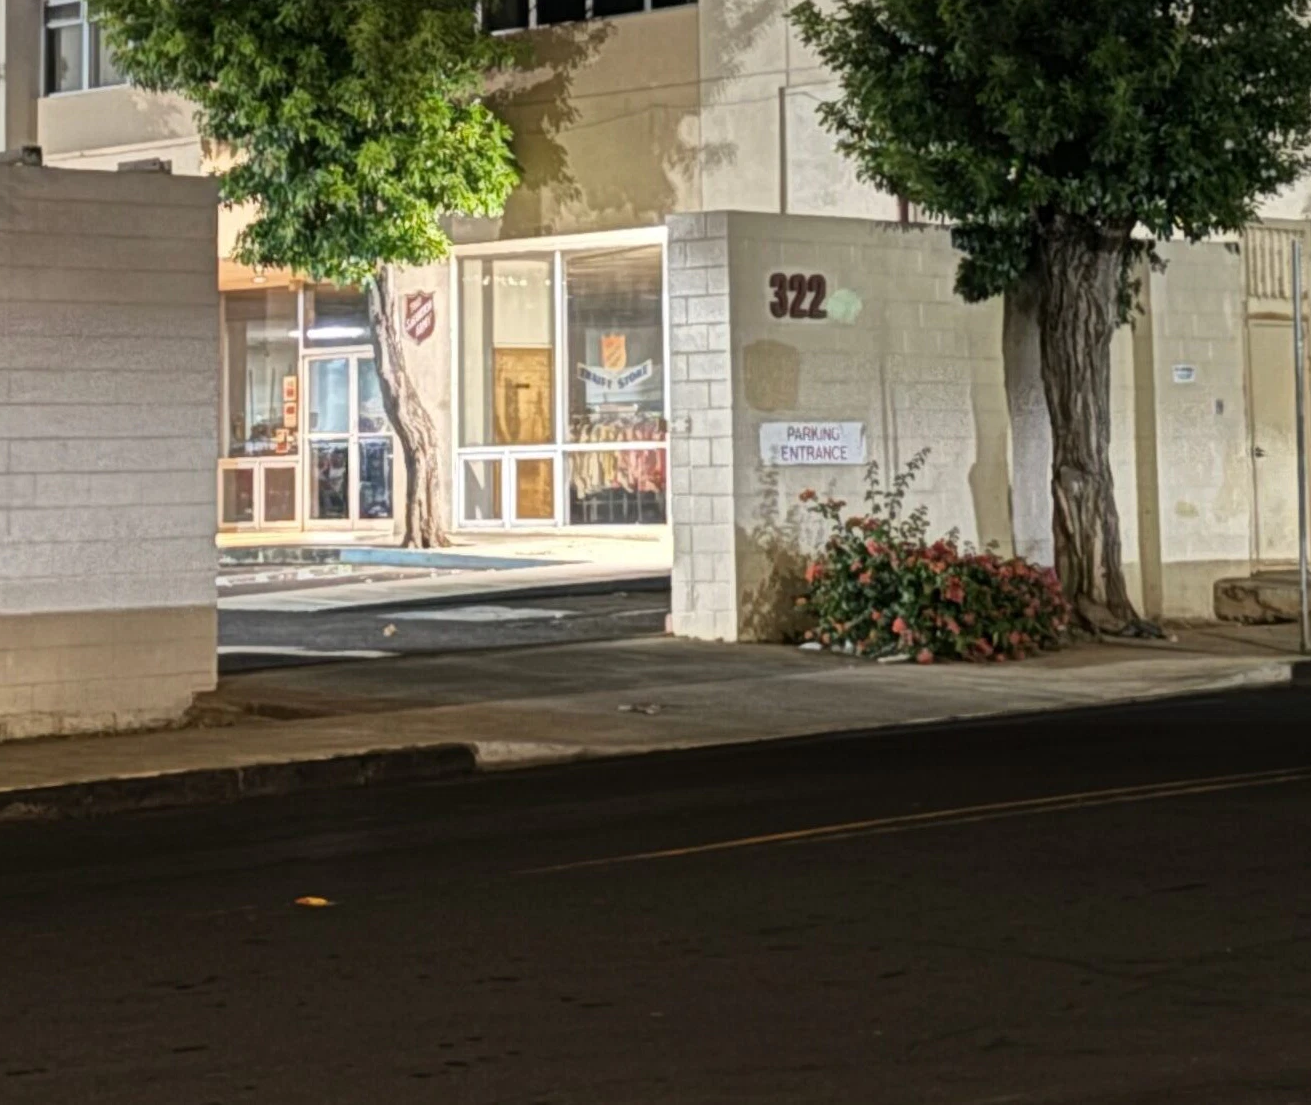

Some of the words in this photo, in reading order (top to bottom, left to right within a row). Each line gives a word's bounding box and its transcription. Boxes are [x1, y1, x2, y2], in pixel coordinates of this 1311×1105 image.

[769, 272, 827, 319] 322
[787, 425, 840, 441] PARKING
[780, 445, 848, 461] ENTRANCE
